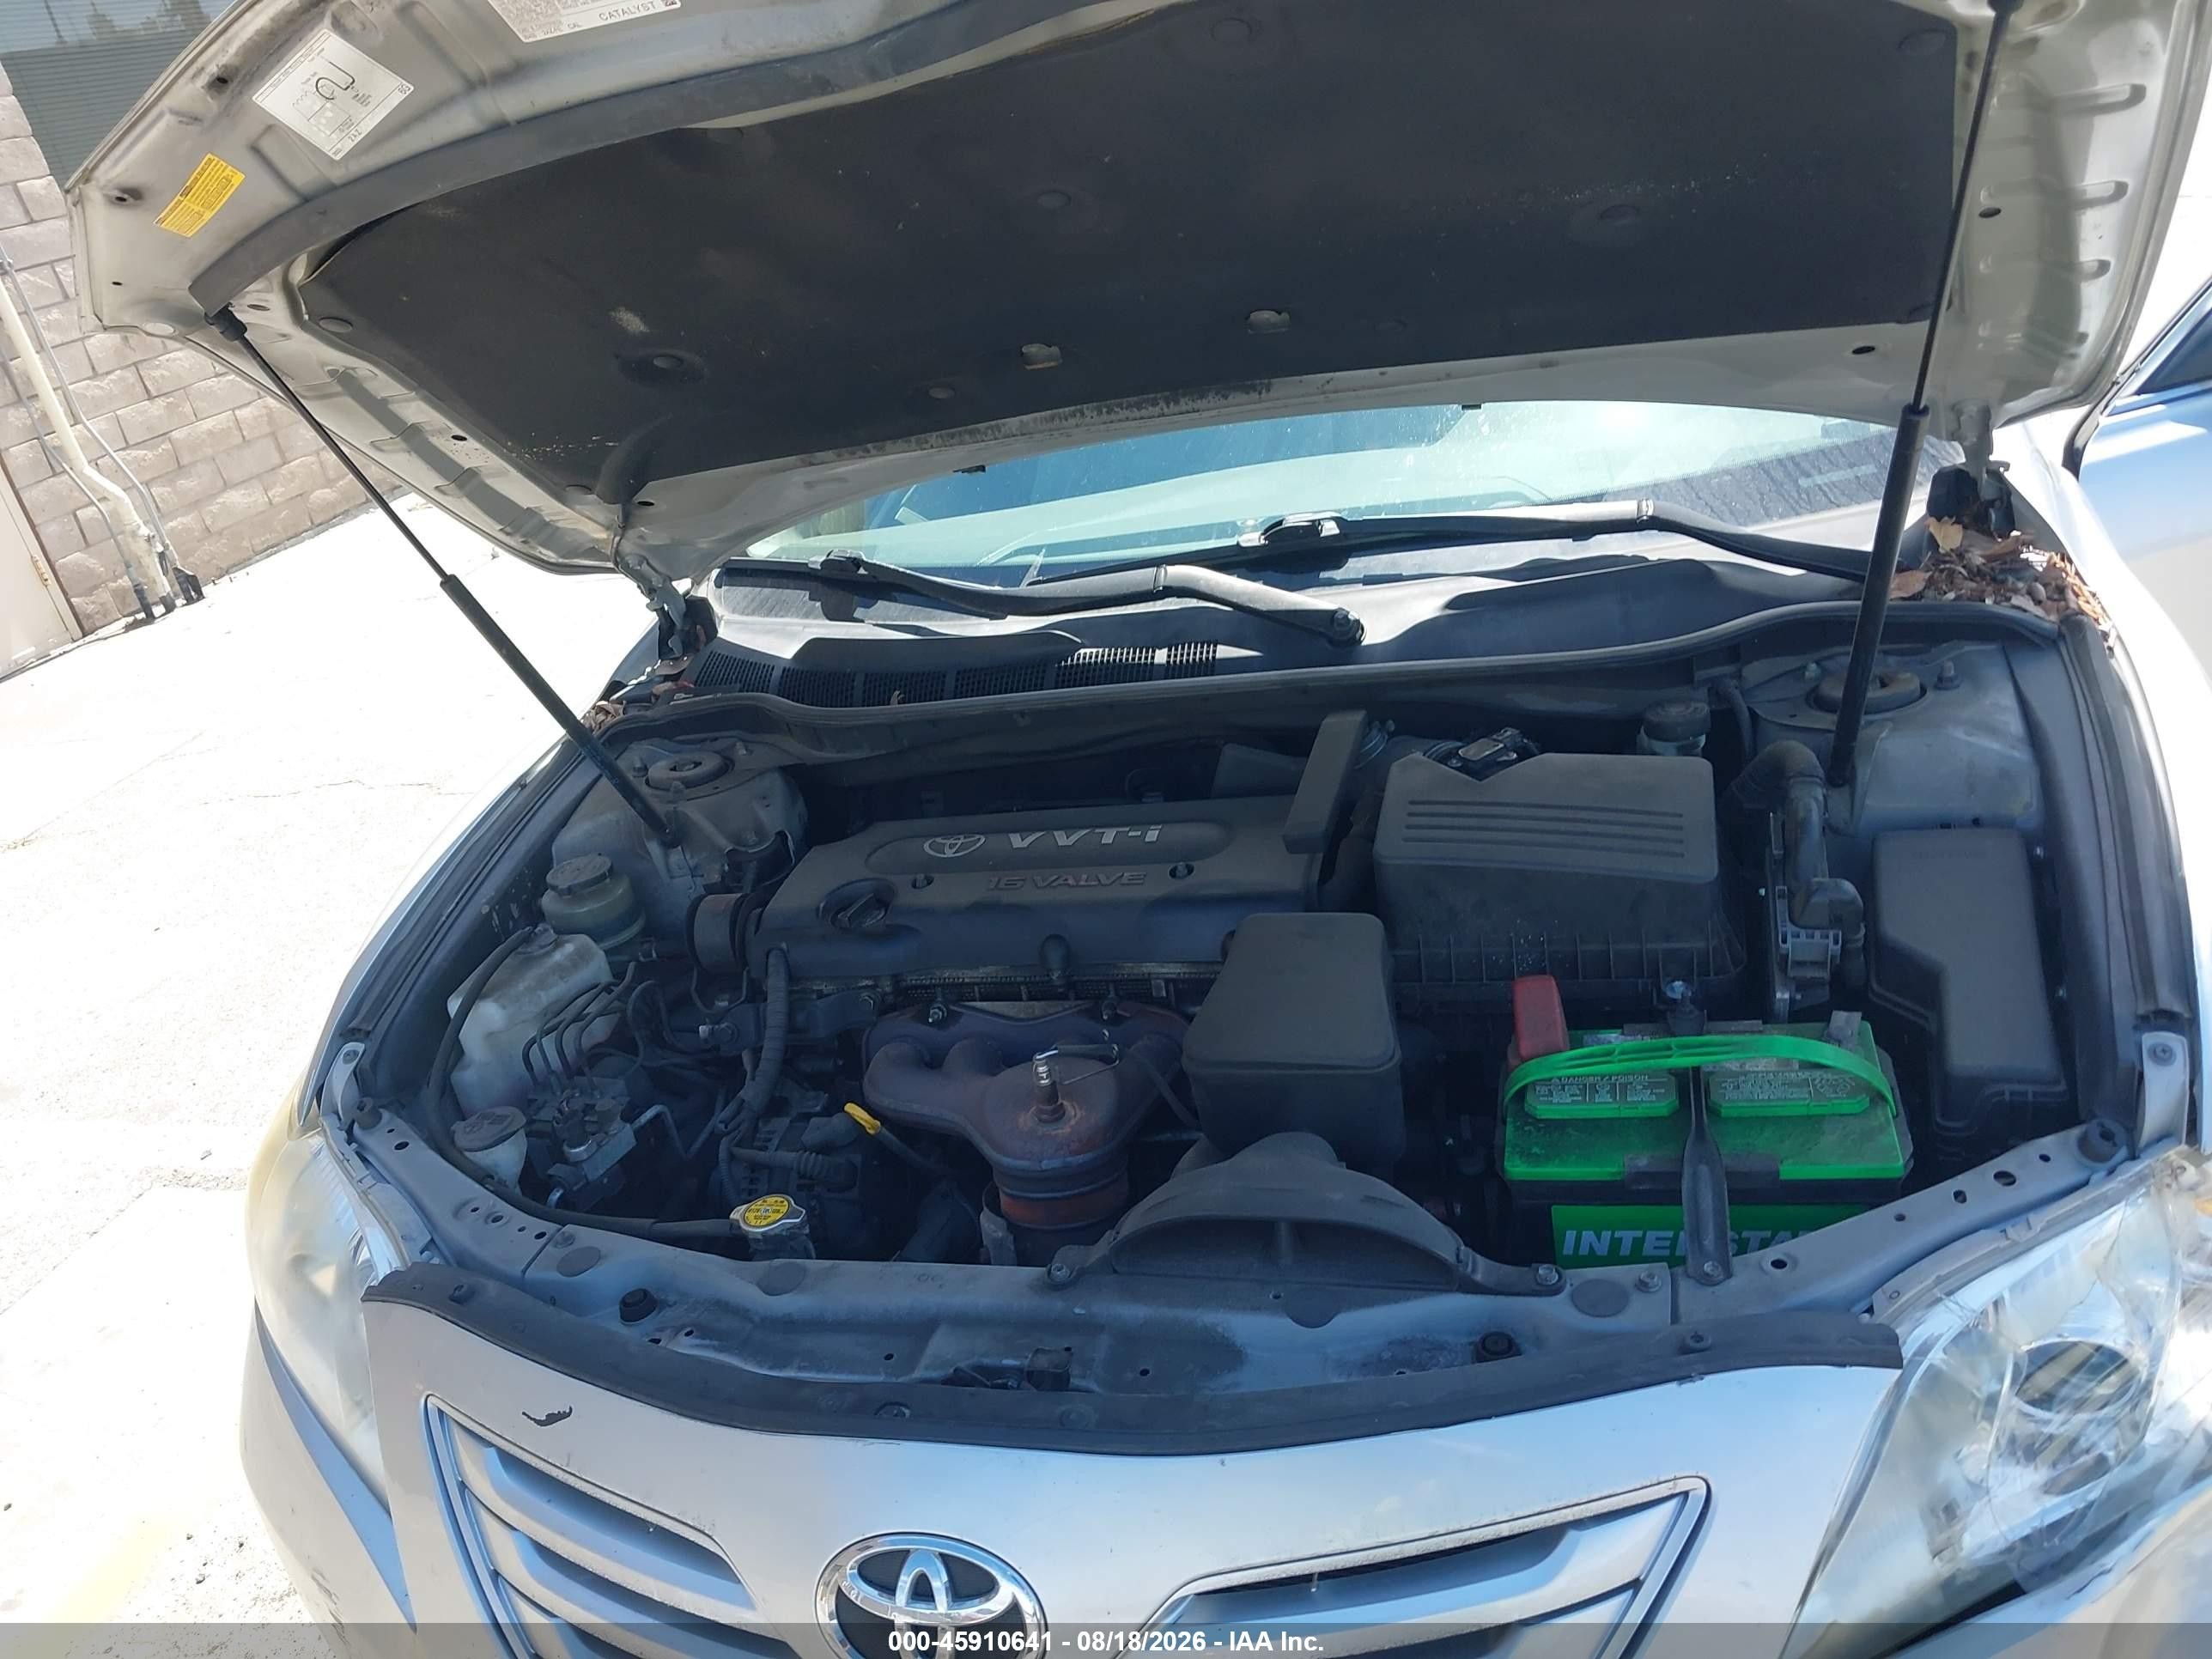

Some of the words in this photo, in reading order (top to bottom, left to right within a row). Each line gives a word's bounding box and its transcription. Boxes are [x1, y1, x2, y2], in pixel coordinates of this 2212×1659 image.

[599, 2, 656, 21] CATALYST
[1009, 825, 1162, 848] VVT-i
[988, 877, 1026, 890] 16
[1033, 872, 1146, 889] VALVE
[1612, 1073, 1649, 1082] POISON
